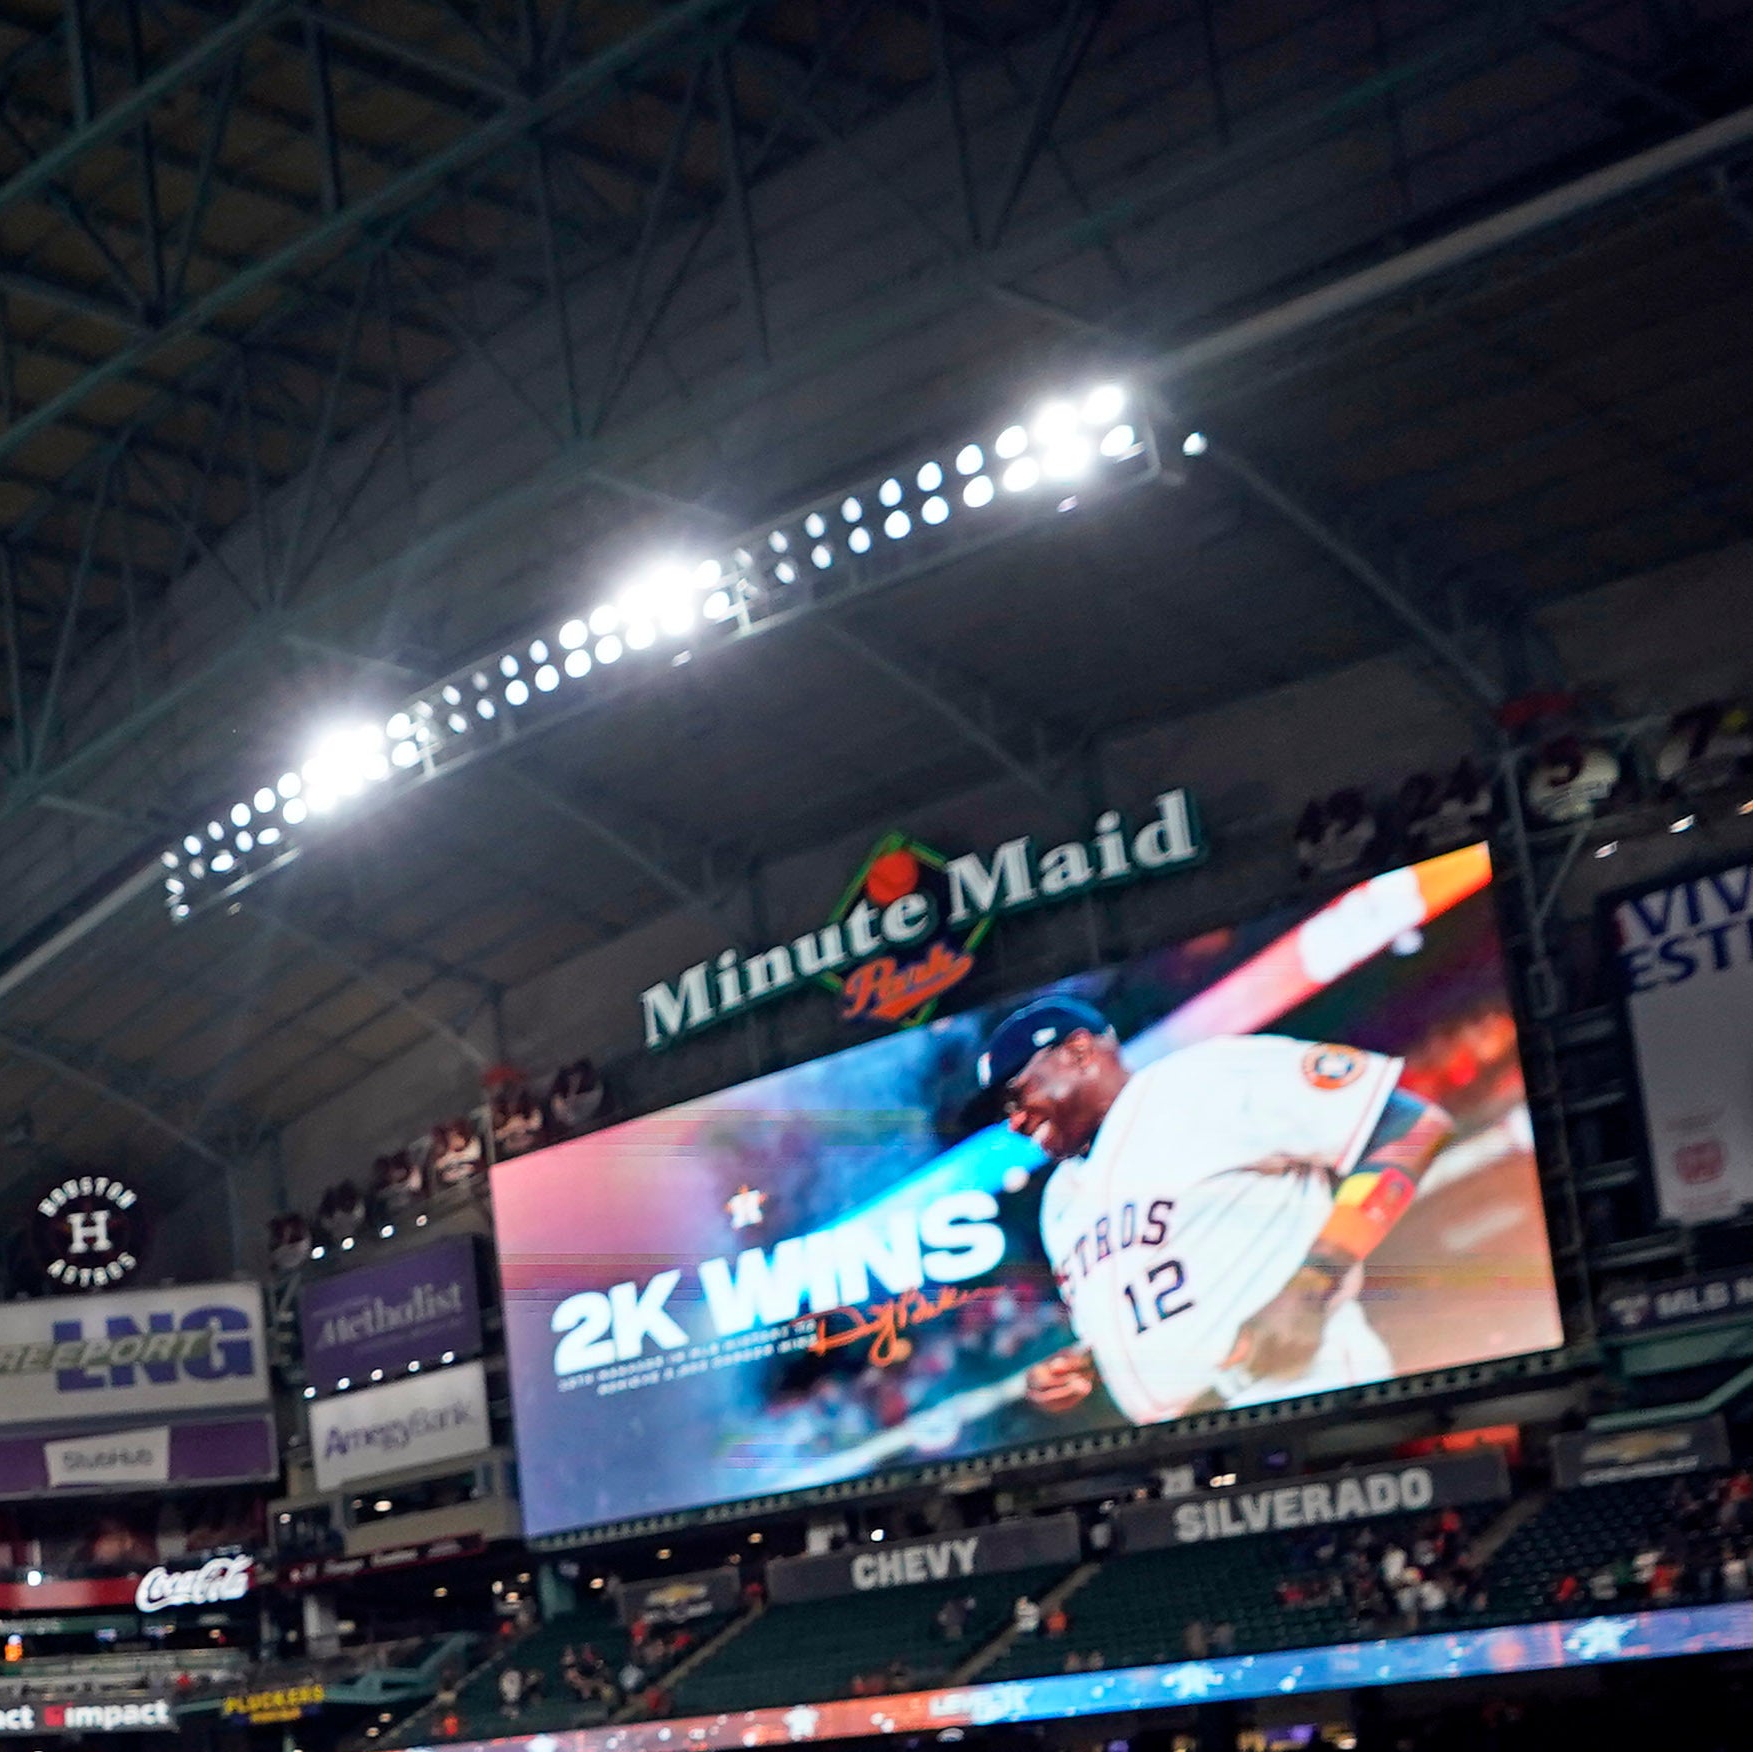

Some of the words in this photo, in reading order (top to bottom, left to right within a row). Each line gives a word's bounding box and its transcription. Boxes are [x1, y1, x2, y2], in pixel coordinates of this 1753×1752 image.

[641, 893, 931, 1050] Minute
[945, 789, 1199, 924] Maid
[37, 1176, 138, 1217] HOUSTON
[67, 1209, 113, 1254] H
[46, 1251, 137, 1288] ASTROS
[551, 1269, 690, 1376] 2K
[698, 1190, 1007, 1336] WINS
[1123, 1259, 1196, 1335] 12
[52, 1304, 255, 1394] LNG
[1173, 1466, 1434, 1543] SILVERADO
[851, 1536, 981, 1592] CHEVY
[64, 1699, 171, 1730] impact
